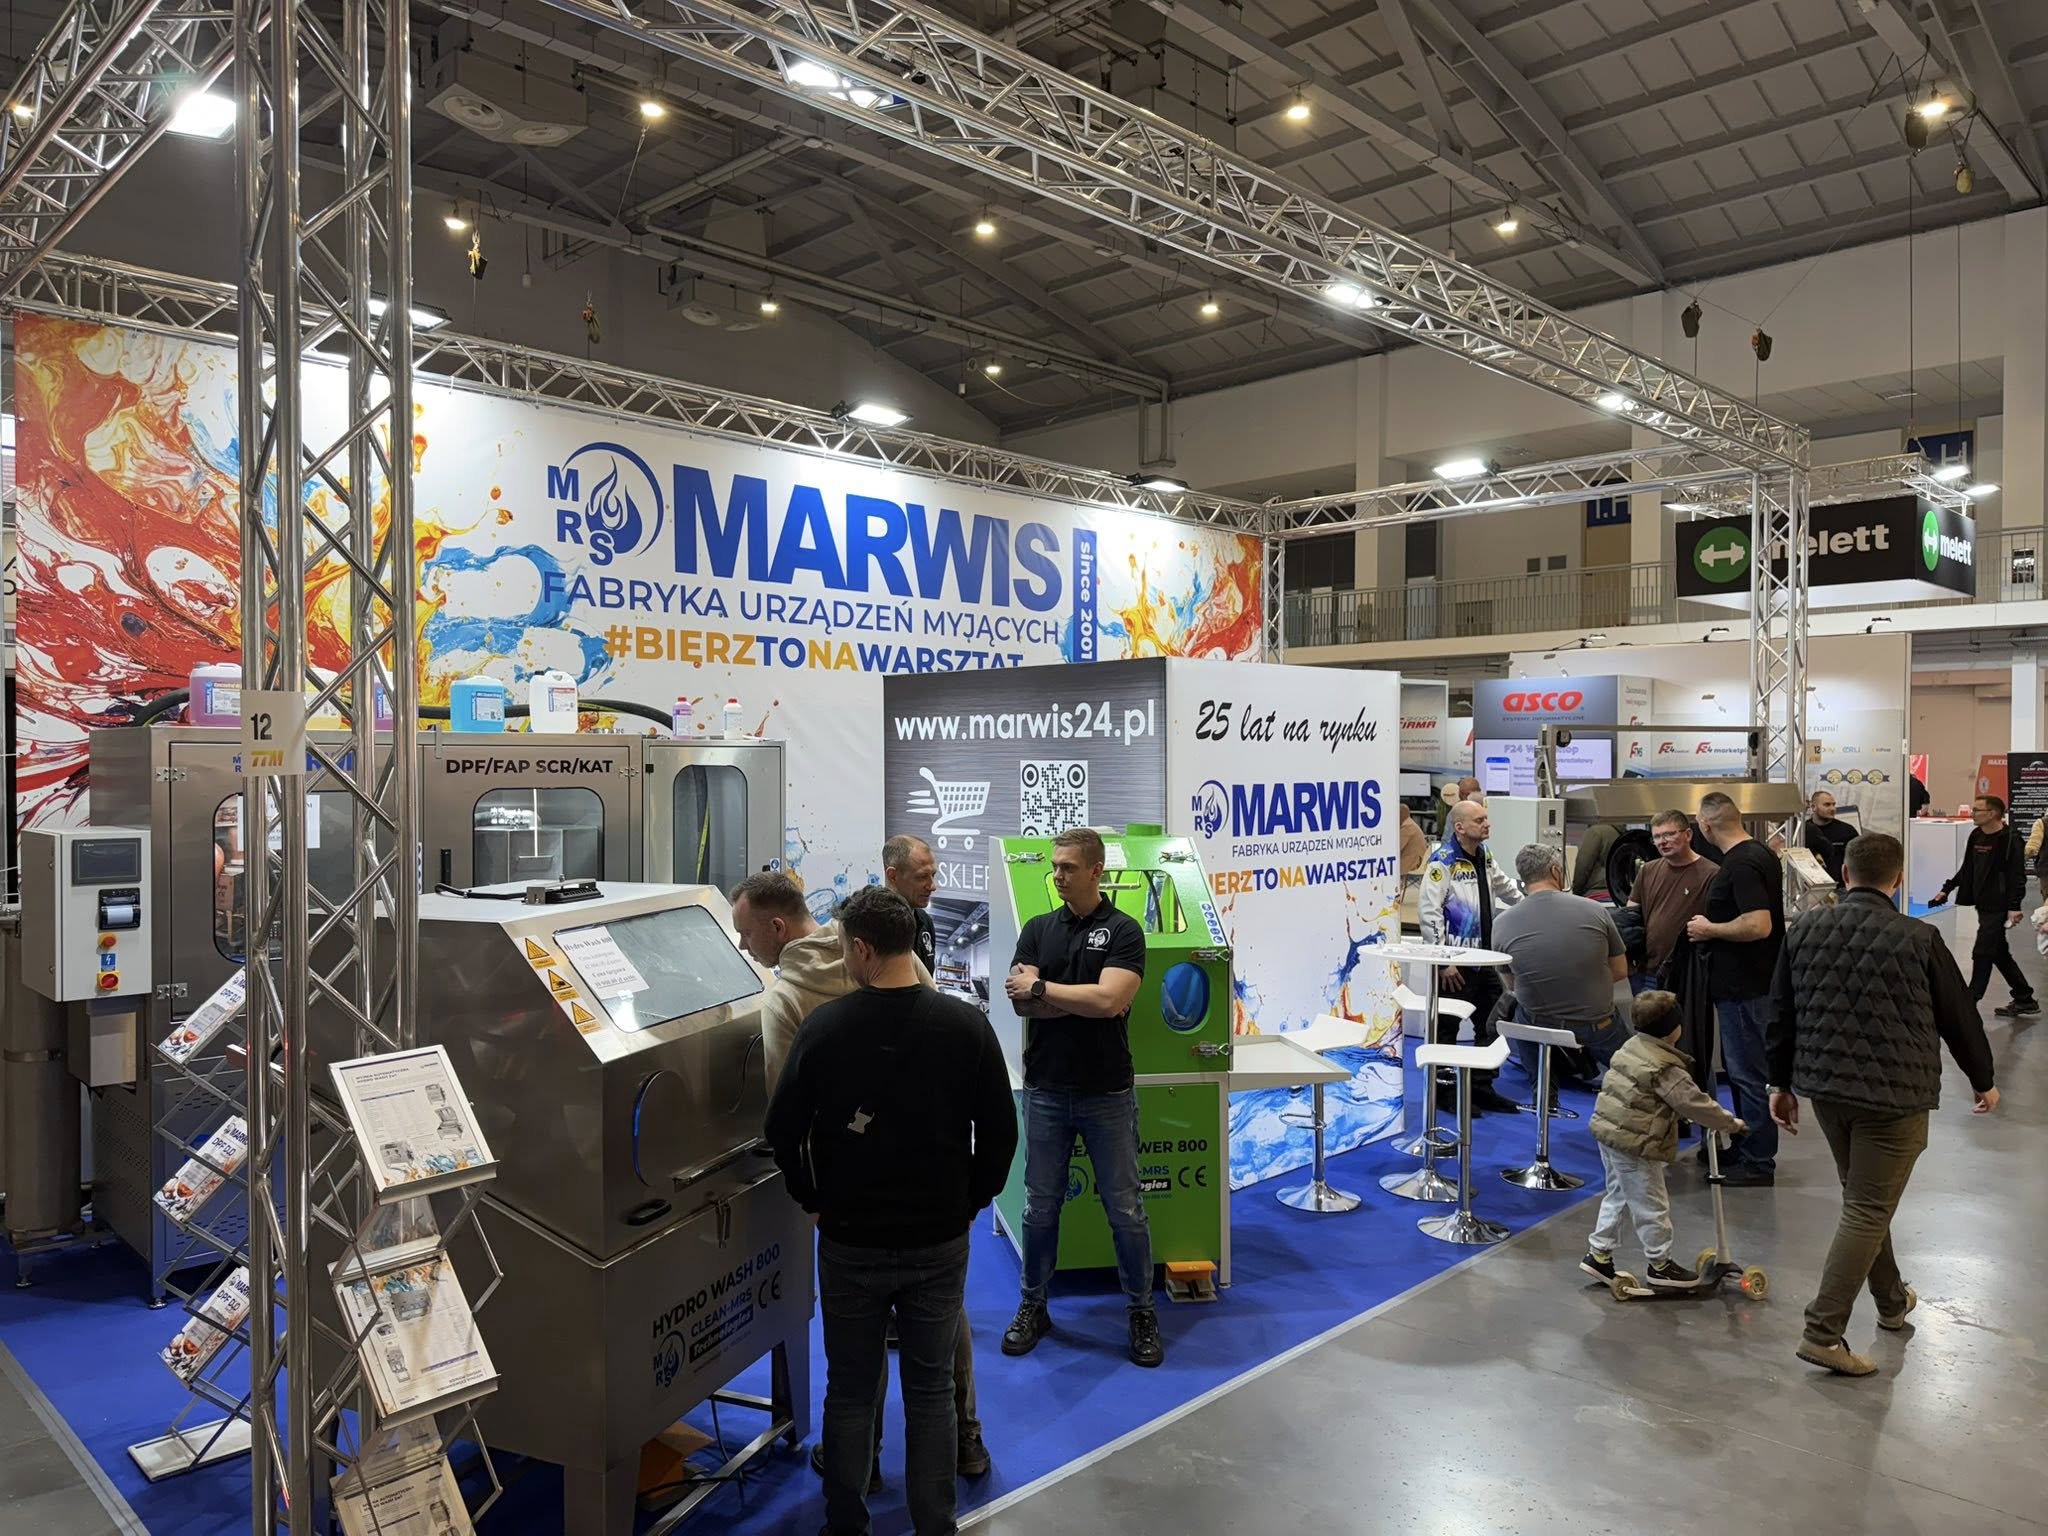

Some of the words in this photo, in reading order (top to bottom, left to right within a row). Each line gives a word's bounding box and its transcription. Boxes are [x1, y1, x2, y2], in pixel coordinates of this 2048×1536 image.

[673, 464, 1062, 612] MARWIS
[1939, 532, 1972, 567] melett
[1080, 541, 1093, 603] since
[544, 571, 728, 618] FABRYKA
[740, 590, 913, 635] URZĄDZEŃ
[924, 608, 1058, 647] MYJĄCYCH
[1080, 609, 1093, 661] 2001
[894, 701, 1154, 745] www.marwis24.pl
[1503, 691, 1583, 712] asco
[250, 713, 272, 740] 12
[1196, 700, 1232, 741] 25
[1240, 704, 1276, 742] lat
[1283, 718, 1311, 742] na
[1319, 707, 1377, 754] rynku
[446, 758, 530, 774] DPF/FAP
[535, 758, 613, 774] SCR/KAT
[1232, 779, 1382, 838] MARWIS
[1232, 841, 1279, 857] FABRYKA
[1281, 836, 1333, 855] URZĄDZEŃ
[1336, 834, 1382, 852] MYJĄCYCH
[1176, 1139, 1207, 1153] 800
[653, 1290, 707, 1338] HYDRO
[711, 1261, 752, 1299] WASH
[756, 1243, 780, 1271] 800
[691, 1288, 752, 1337] CLEAN-MRS
